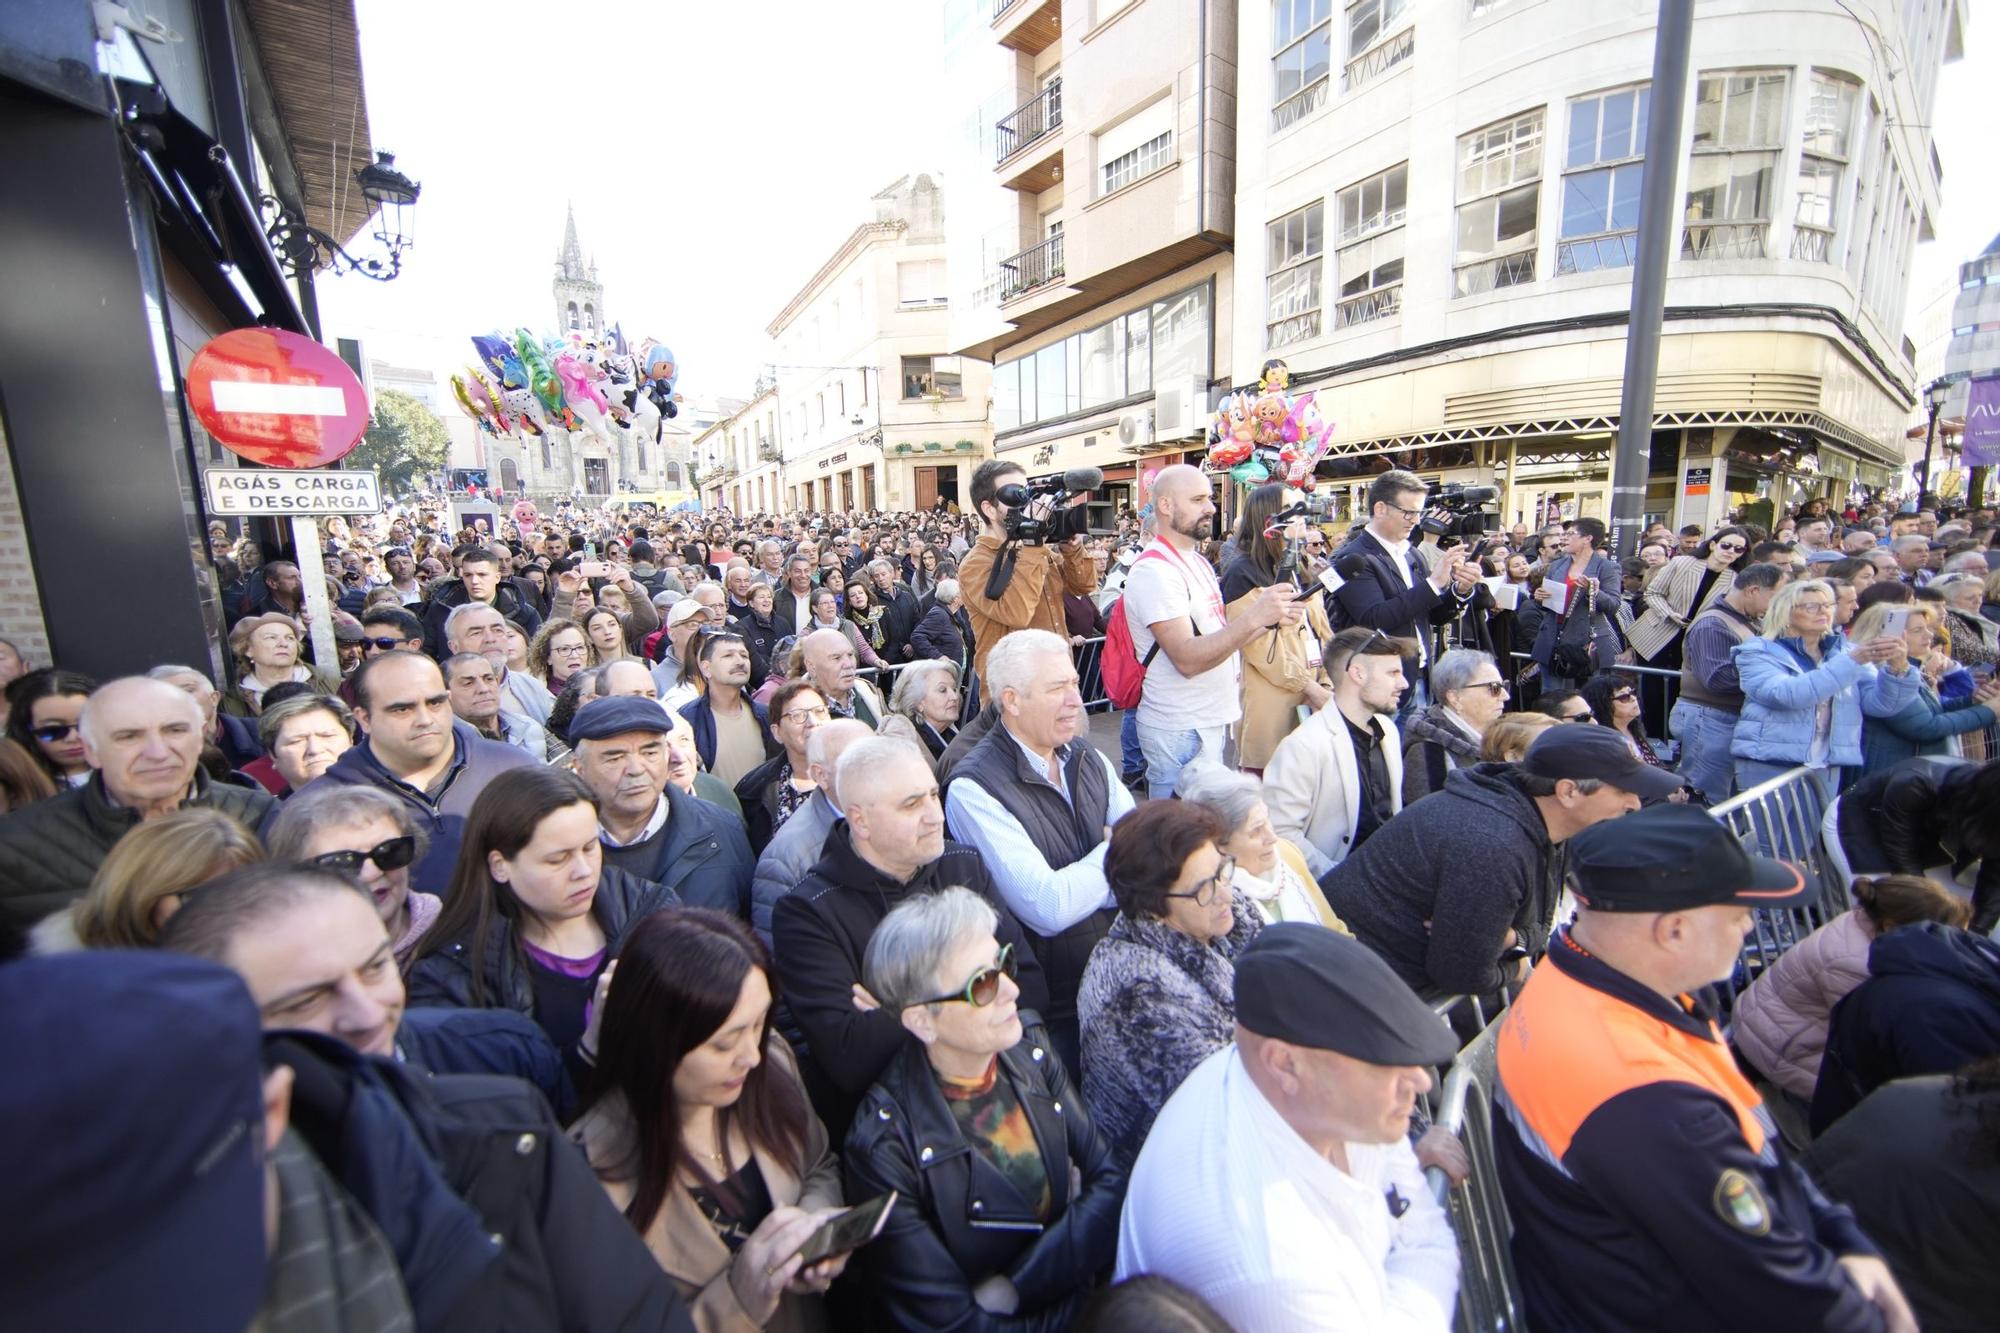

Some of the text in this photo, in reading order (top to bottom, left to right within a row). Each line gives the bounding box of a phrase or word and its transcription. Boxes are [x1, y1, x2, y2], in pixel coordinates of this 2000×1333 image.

[218, 474, 369, 490] AGÁS CARGA
[222, 496, 370, 508] E DESCARGA
[1611, 527, 1620, 549] 41km
